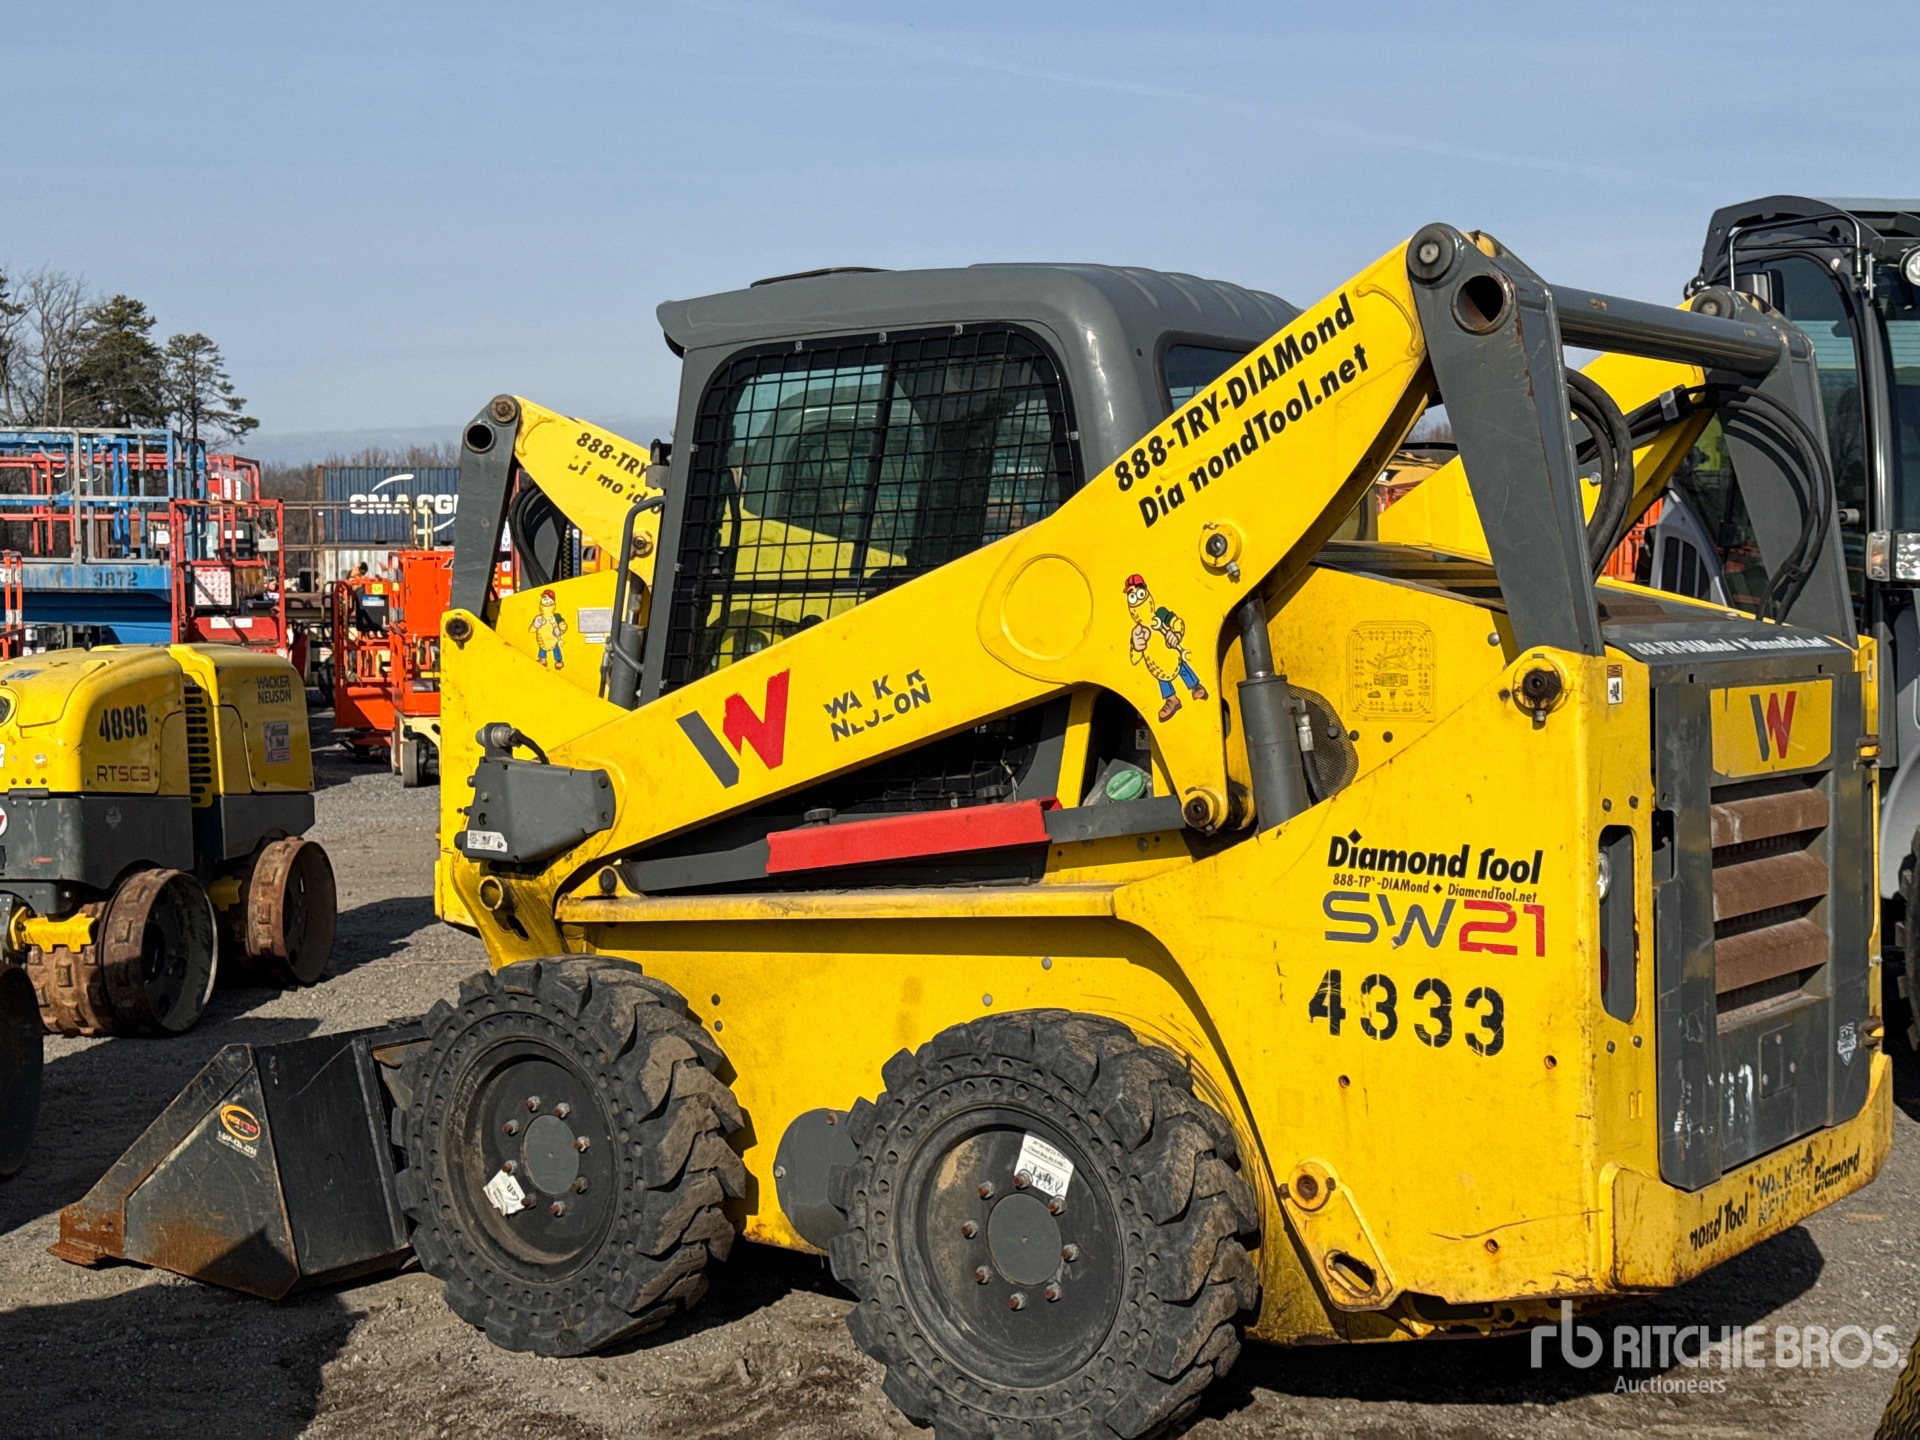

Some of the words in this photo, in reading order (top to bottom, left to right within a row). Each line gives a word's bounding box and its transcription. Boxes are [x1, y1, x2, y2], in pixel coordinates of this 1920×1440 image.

[1114, 292, 1355, 491] 888-TRY-DIAMond
[349, 494, 410, 514] CMA
[93, 571, 139, 587] 3872
[256, 675, 291, 690] WACKER
[257, 688, 292, 705] NEUSON
[98, 703, 149, 743] 4896
[96, 765, 150, 782] RTSC3
[1327, 829, 1470, 878] Diamond
[1322, 890, 1545, 957] SW21
[1309, 969, 1504, 1057] 4333
